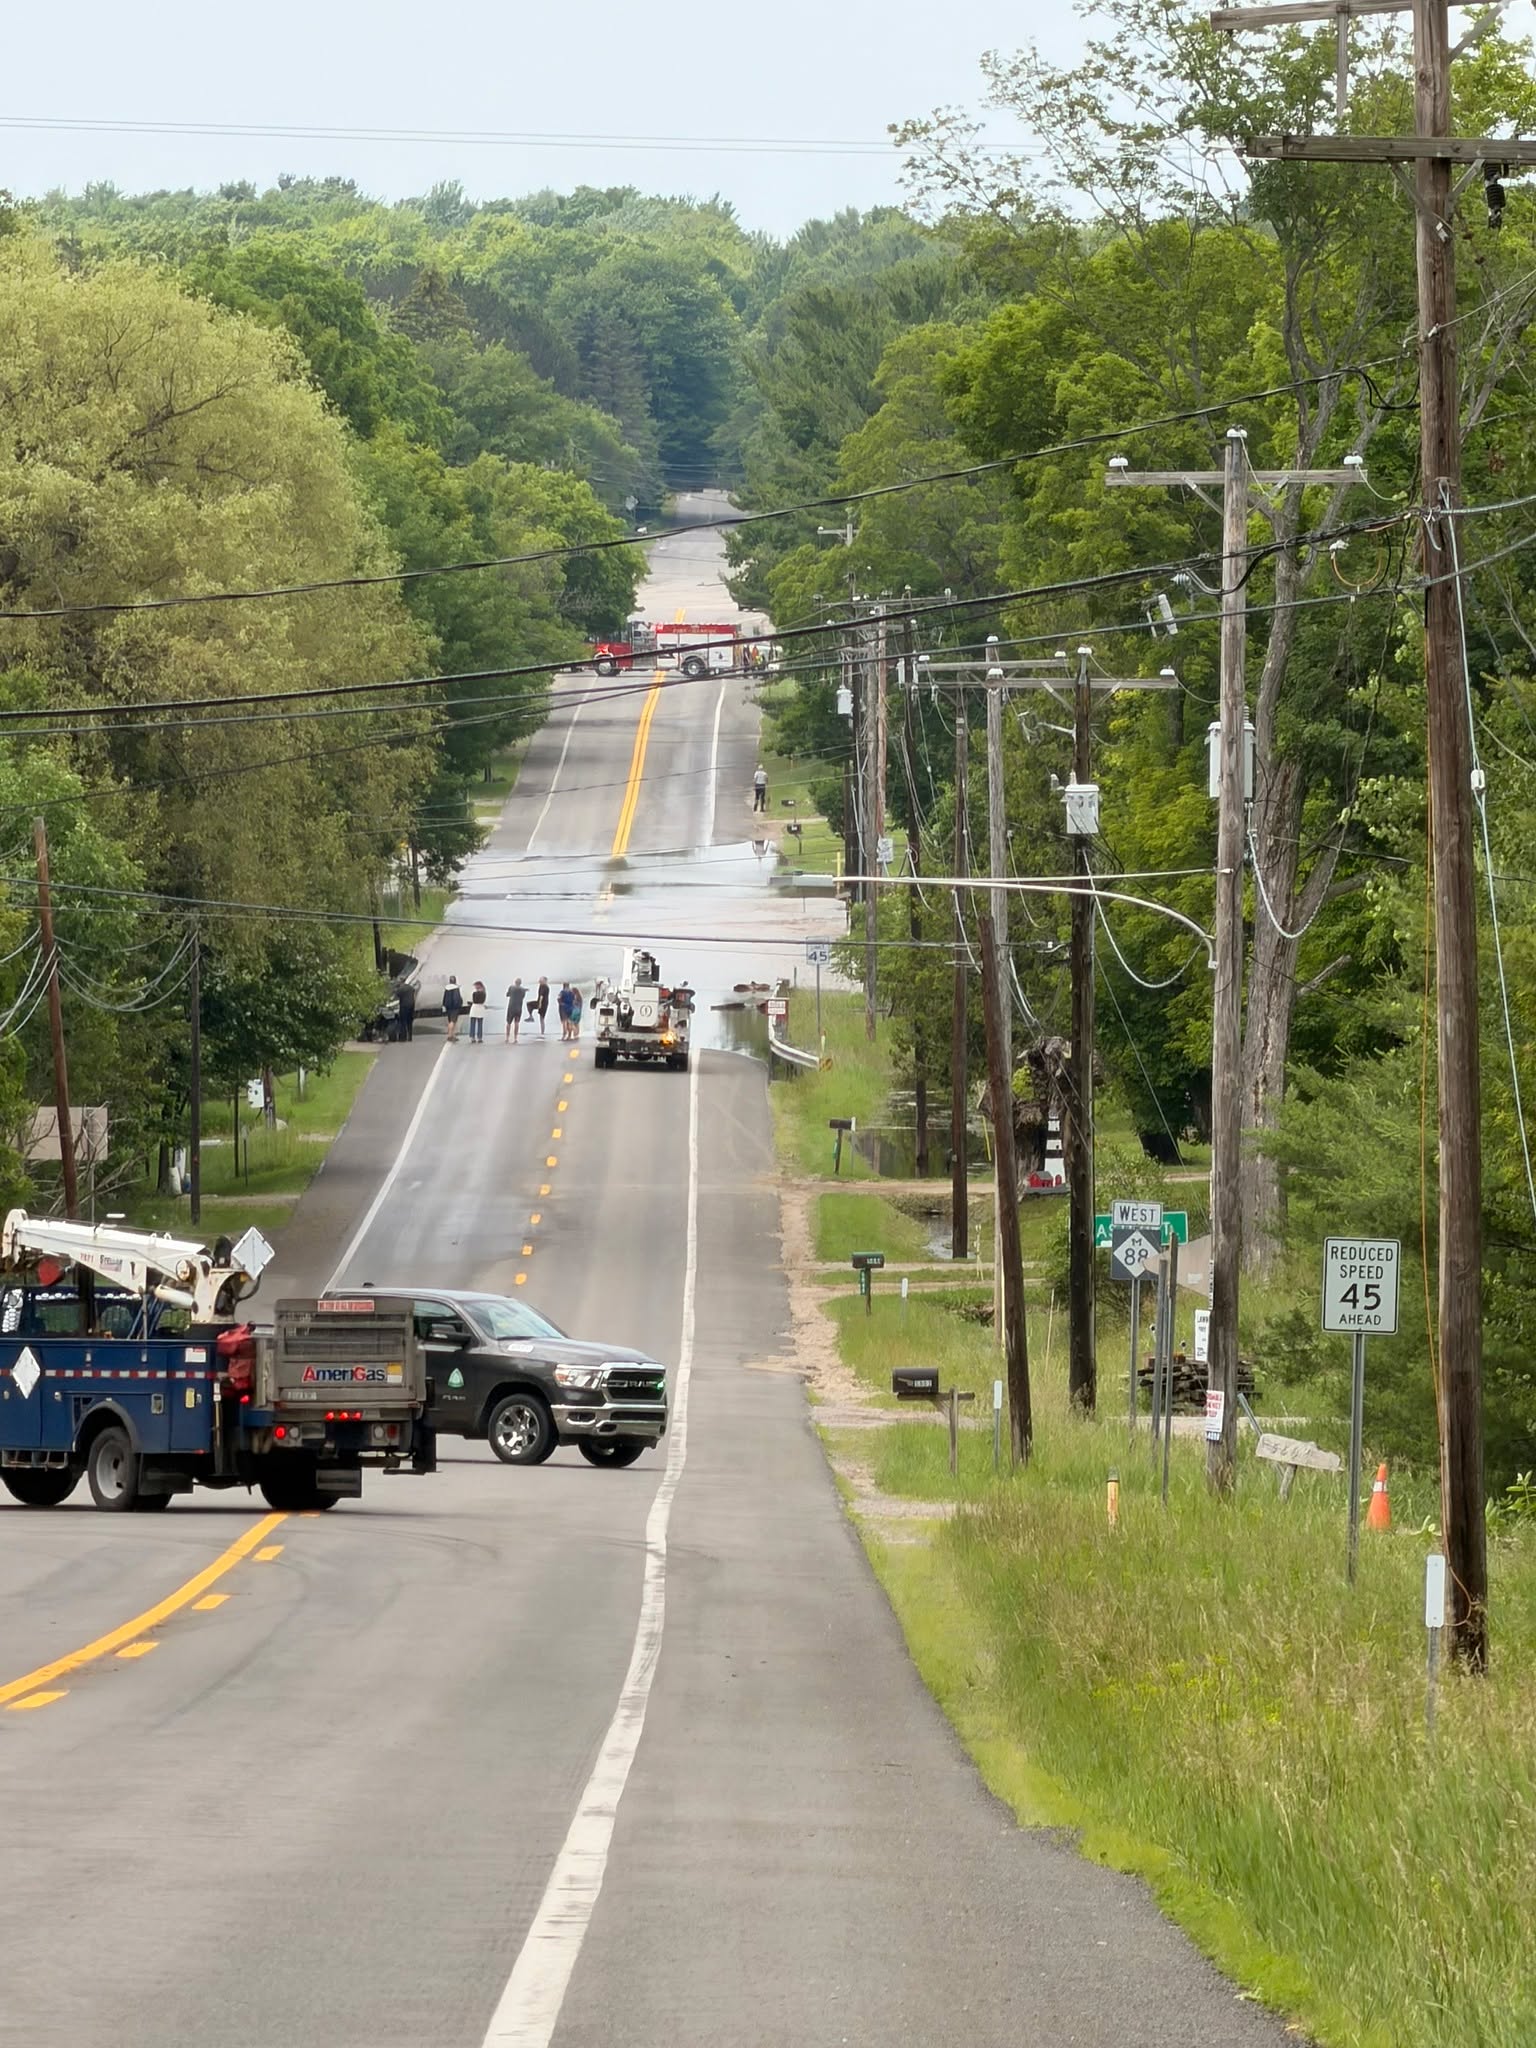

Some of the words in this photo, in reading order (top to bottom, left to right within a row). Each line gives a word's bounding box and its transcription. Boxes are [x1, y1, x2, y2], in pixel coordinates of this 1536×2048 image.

[808, 951, 828, 962] 45
[1119, 1205, 1156, 1222] WEST
[1131, 1238, 1142, 1246] M
[1124, 1248, 1148, 1265] 88
[1330, 1246, 1393, 1262] REDUCED
[1339, 1264, 1384, 1280] SPEED
[1339, 1283, 1382, 1311] 45
[1339, 1313, 1382, 1326] AHEAD
[302, 1366, 386, 1383] AmeriGas
